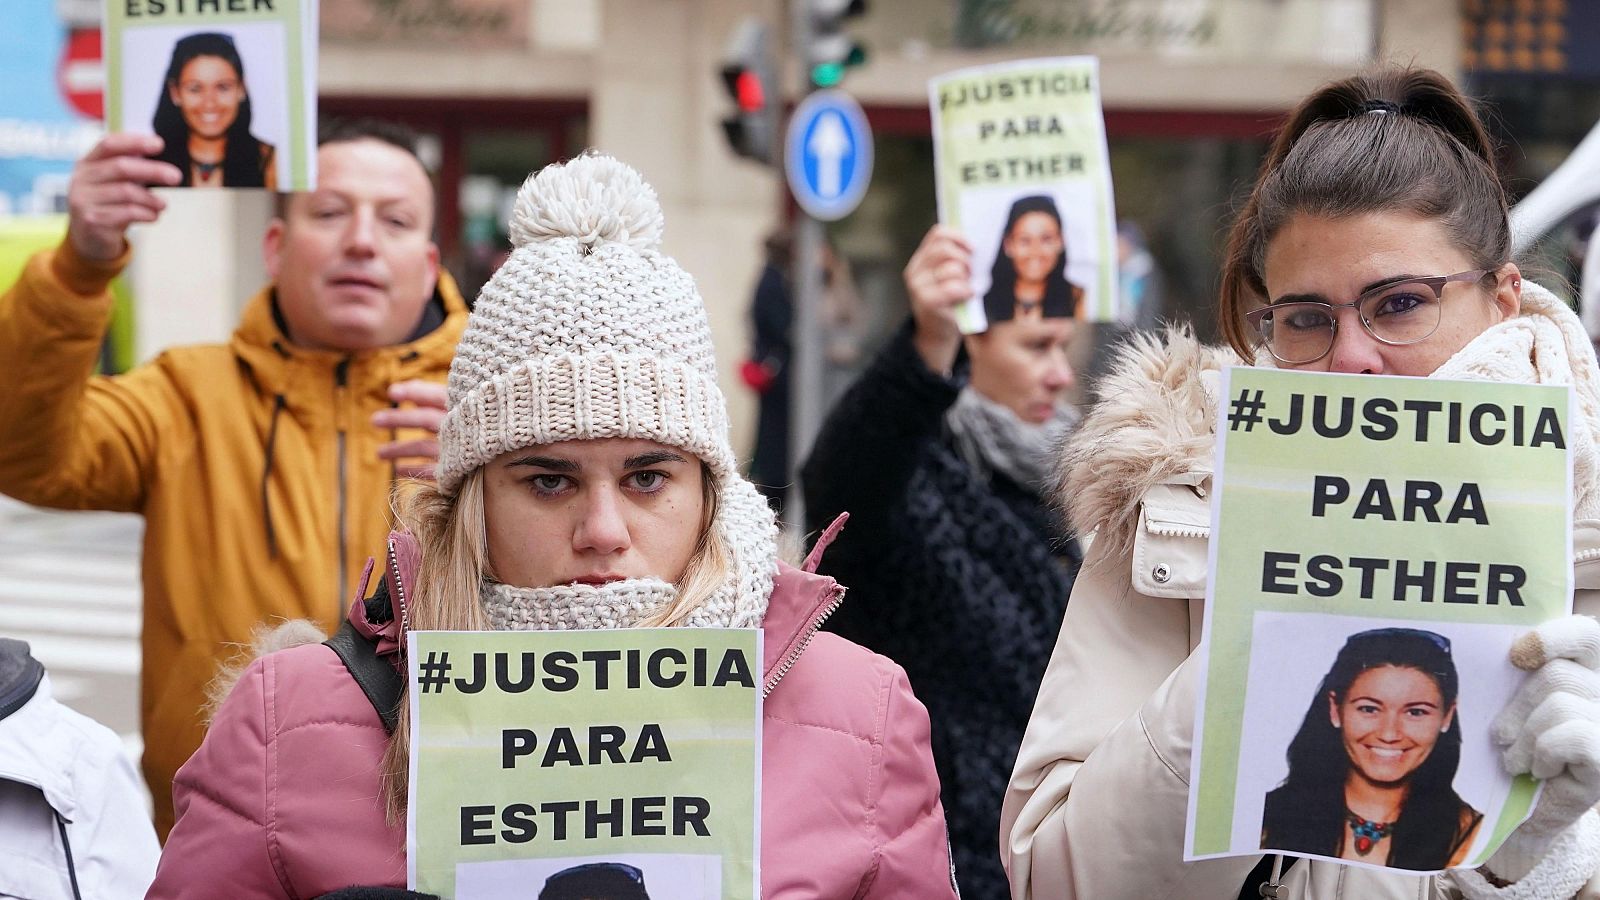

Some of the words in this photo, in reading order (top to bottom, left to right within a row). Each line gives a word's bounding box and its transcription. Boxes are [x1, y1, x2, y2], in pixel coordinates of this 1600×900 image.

[979, 115, 1064, 140] PARA
[960, 153, 1084, 184] ESTHER
[1227, 389, 1566, 449] #JUSTICIA
[1311, 475, 1490, 526] PARA
[1261, 551, 1527, 607] ESTHER
[418, 648, 756, 694] #JUSTICIA
[502, 723, 672, 768] PARA
[460, 796, 711, 845] ESTHER
